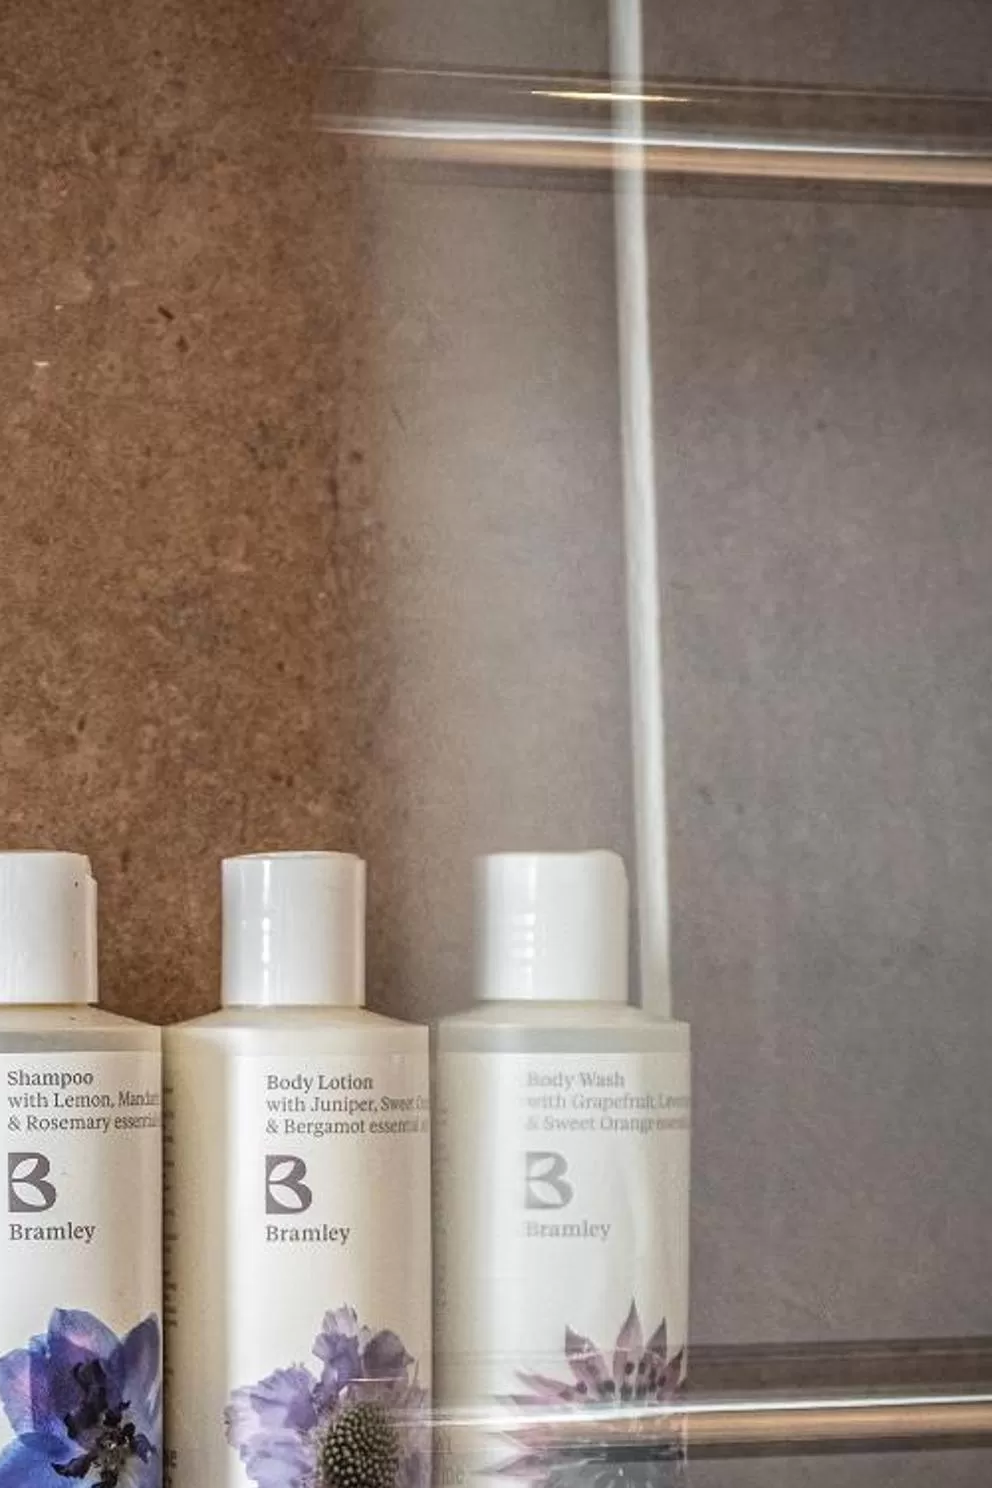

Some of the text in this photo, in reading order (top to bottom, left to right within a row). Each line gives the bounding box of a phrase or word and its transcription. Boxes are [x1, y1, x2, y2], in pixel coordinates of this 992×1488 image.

[8, 1070, 94, 1089] Shampoo
[266, 1074, 373, 1094] Body Lotion
[526, 1071, 626, 1092] Body Wash
[8, 1093, 48, 1108] with
[53, 1092, 115, 1109] Lemon,
[266, 1096, 307, 1112] with
[310, 1095, 378, 1115] Juniper,
[526, 1092, 567, 1109] with
[8, 1116, 21, 1131] &
[26, 1115, 110, 1133] Rosemary
[265, 1118, 279, 1134] &
[284, 1118, 366, 1137] Bergamot
[543, 1115, 596, 1132] Sweet
[9, 1222, 96, 1243] Bramley
[265, 1224, 351, 1246] Bramley
[525, 1220, 612, 1242] Bramley
